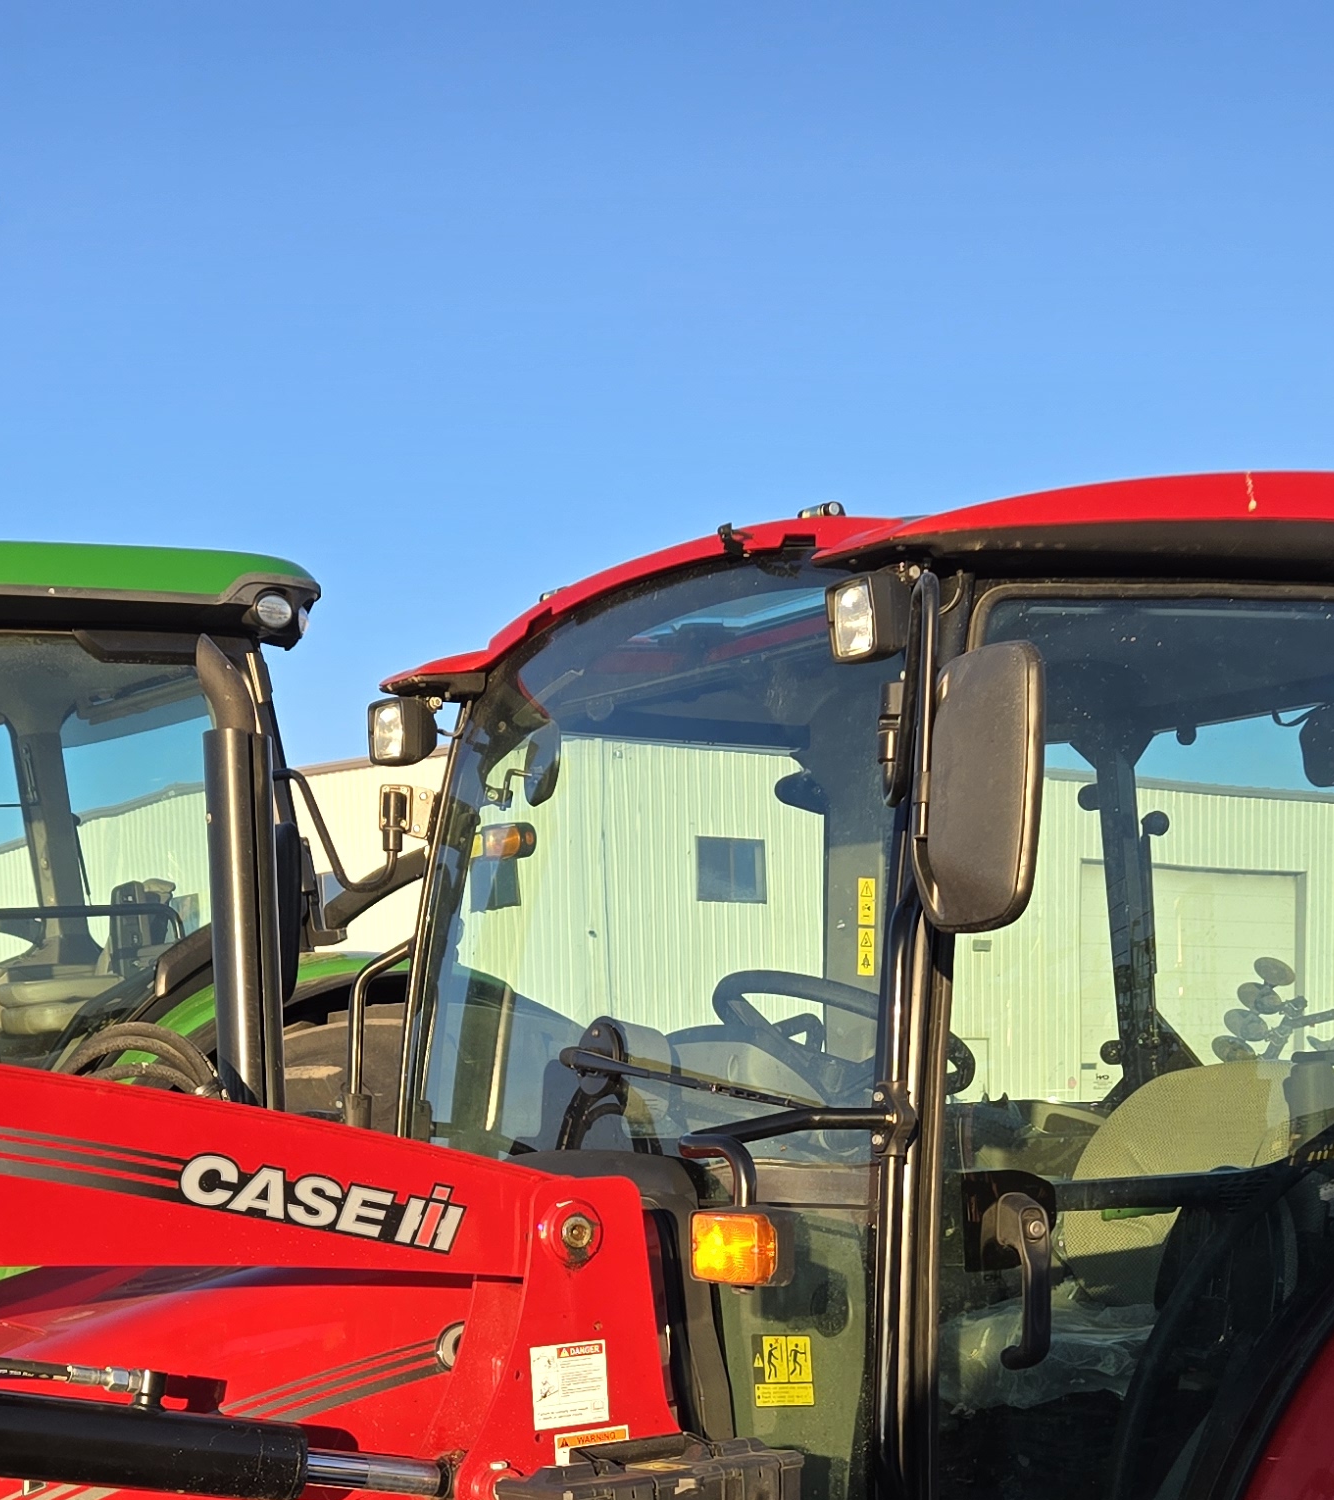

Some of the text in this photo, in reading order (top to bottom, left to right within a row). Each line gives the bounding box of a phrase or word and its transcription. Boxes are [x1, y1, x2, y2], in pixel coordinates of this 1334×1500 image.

[180, 1155, 396, 1238] CASE
[570, 1345, 600, 1356] DANGER
[577, 1431, 616, 1445] WARNING
